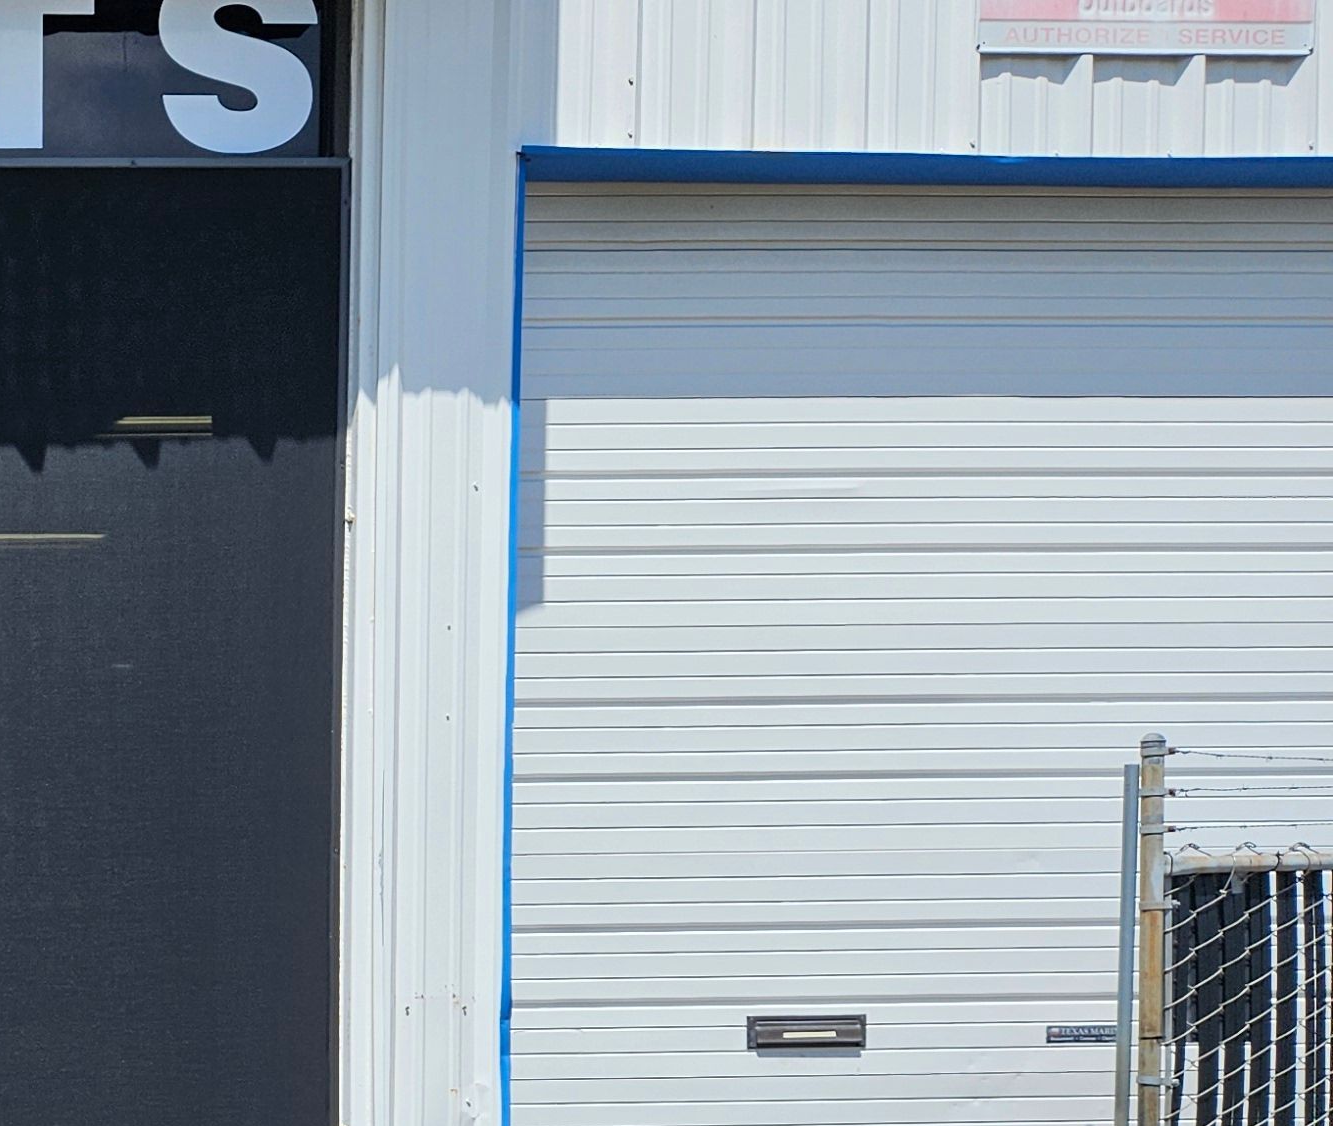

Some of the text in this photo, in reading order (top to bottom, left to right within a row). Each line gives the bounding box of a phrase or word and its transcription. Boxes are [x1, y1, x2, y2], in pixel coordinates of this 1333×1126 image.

[1004, 26, 1286, 45] AUTHORIZE SERVICE
[1061, 1027, 1089, 1036] TEXAS
